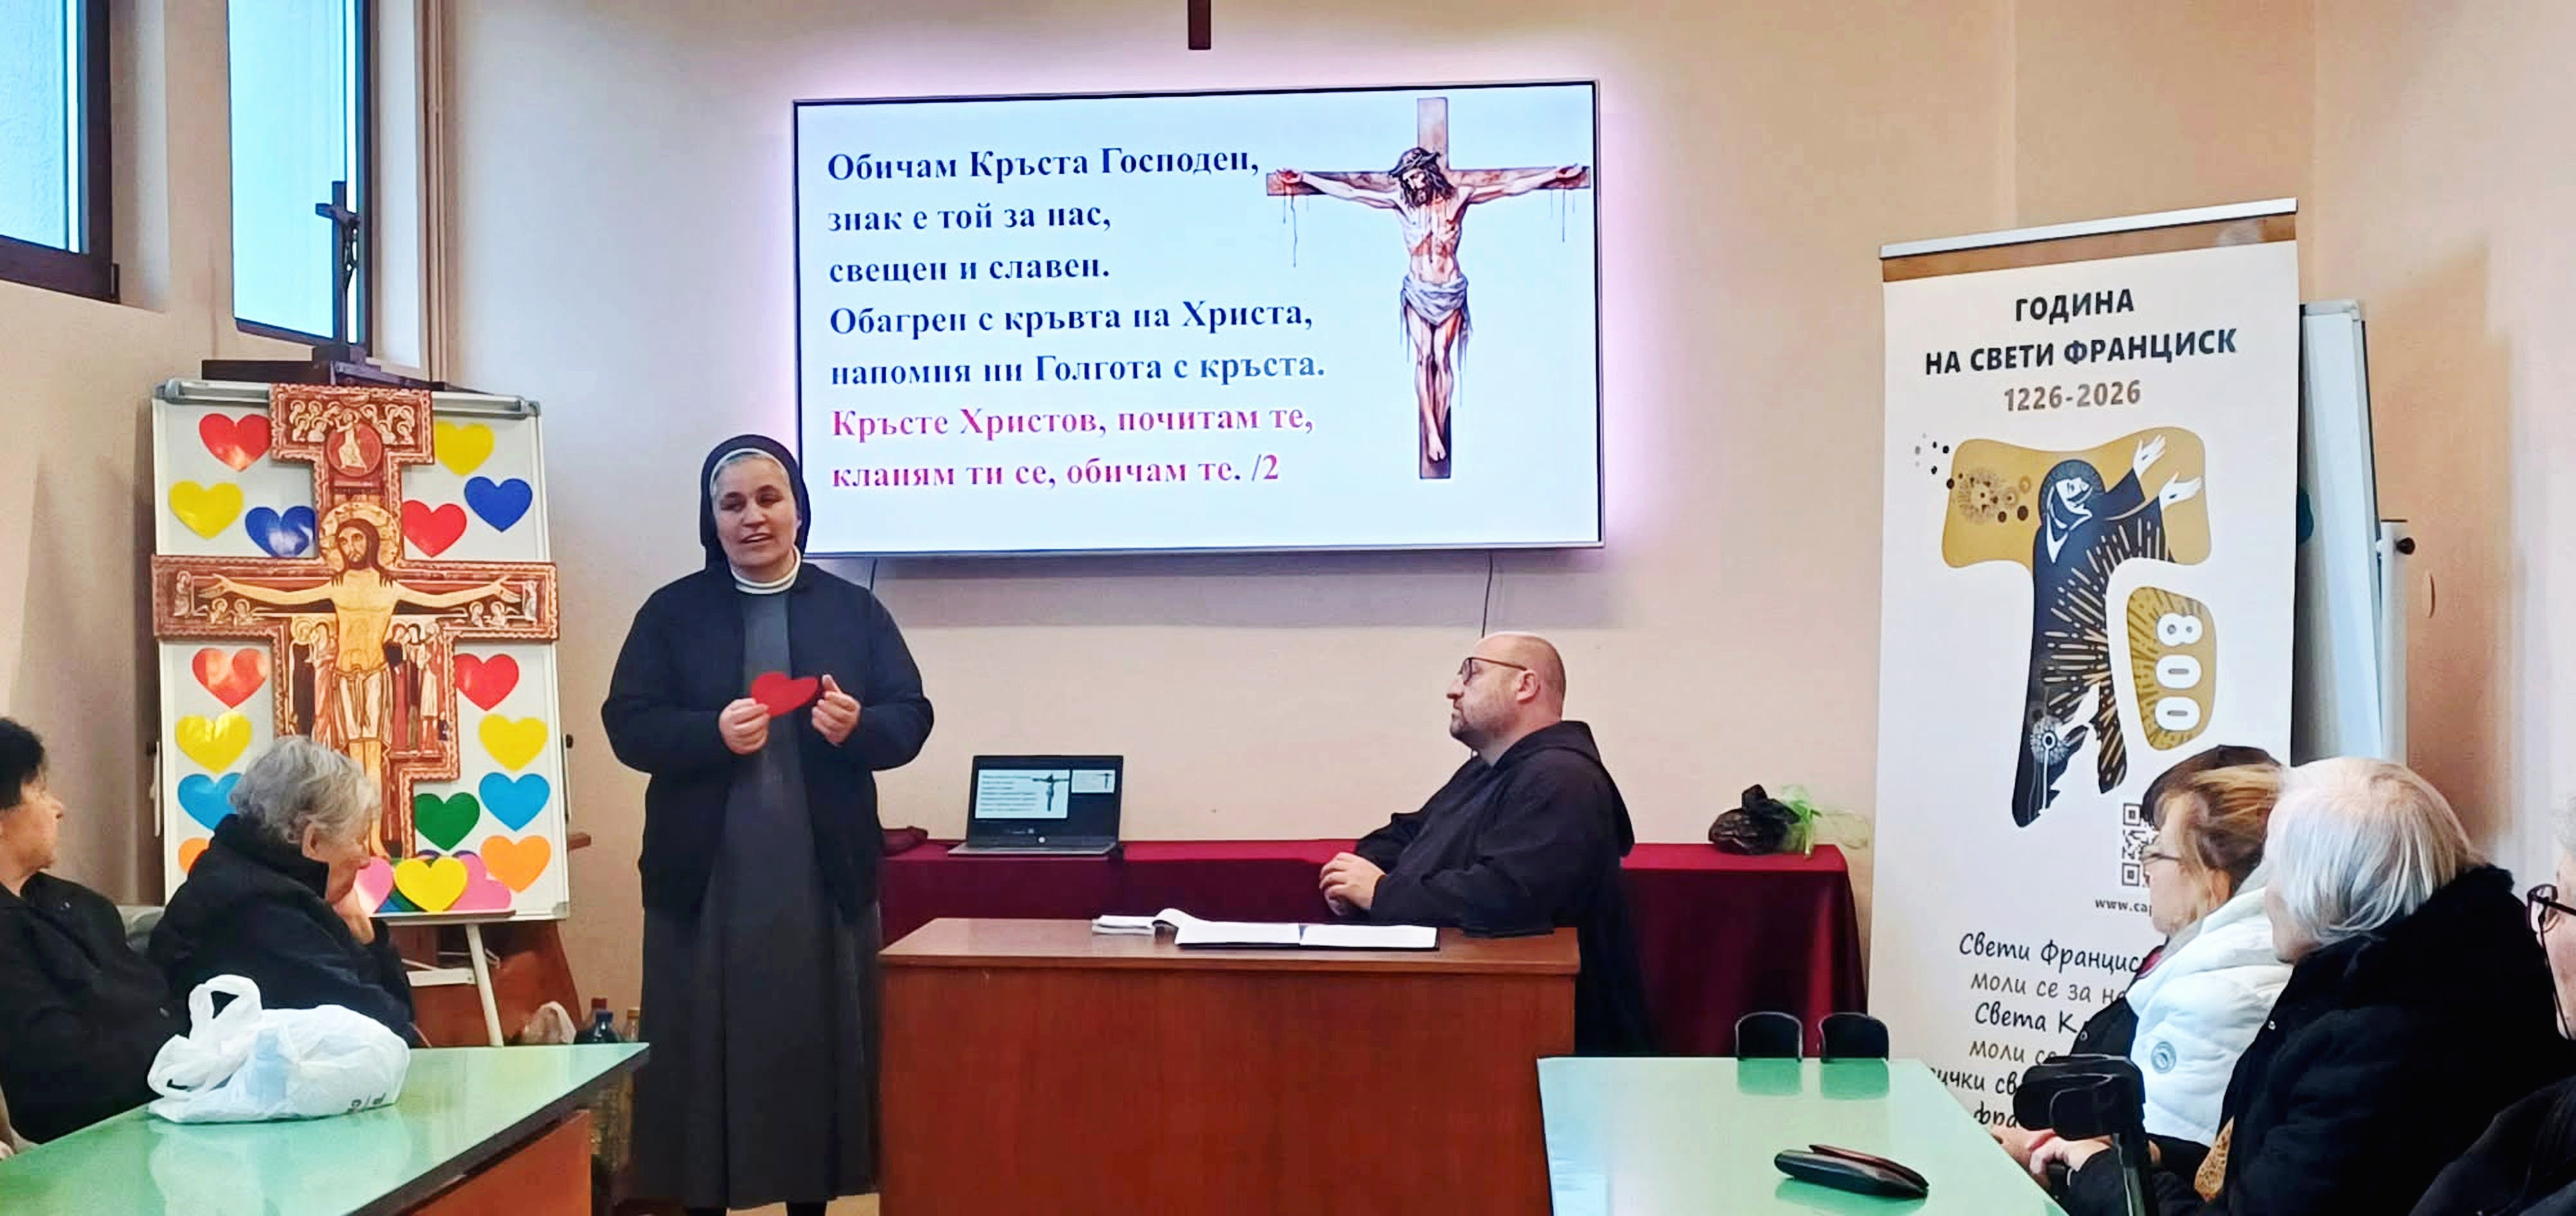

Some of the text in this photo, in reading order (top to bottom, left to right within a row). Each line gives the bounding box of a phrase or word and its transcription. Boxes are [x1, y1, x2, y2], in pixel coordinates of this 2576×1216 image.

[827, 147, 1259, 185] Обичам Кръста Господен,
[828, 202, 1111, 233] знак е той за нас,
[829, 258, 1110, 284] свещен и славен.
[829, 299, 1312, 341] Обагрен с кръвта на Христа,
[2016, 289, 2134, 325] ГОДИНА
[1926, 328, 2236, 375] НА СВЕТИ ФРАНЦИСК
[832, 354, 1325, 386] напомня ни Голгота с кръста.
[2004, 379, 2140, 412] 1226-2026
[833, 407, 1314, 444] Кръсте Христов, почитам те,
[832, 453, 1279, 489] кланям ти се, обичам те. /2
[2155, 613, 2202, 731] 800
[1959, 931, 2142, 974] Свети Францис
[1970, 973, 2026, 995] моли
[2036, 980, 2058, 998] се
[2068, 984, 2091, 1002] за
[1975, 1001, 2046, 1031] Света
[1969, 1040, 2024, 1063] моли
